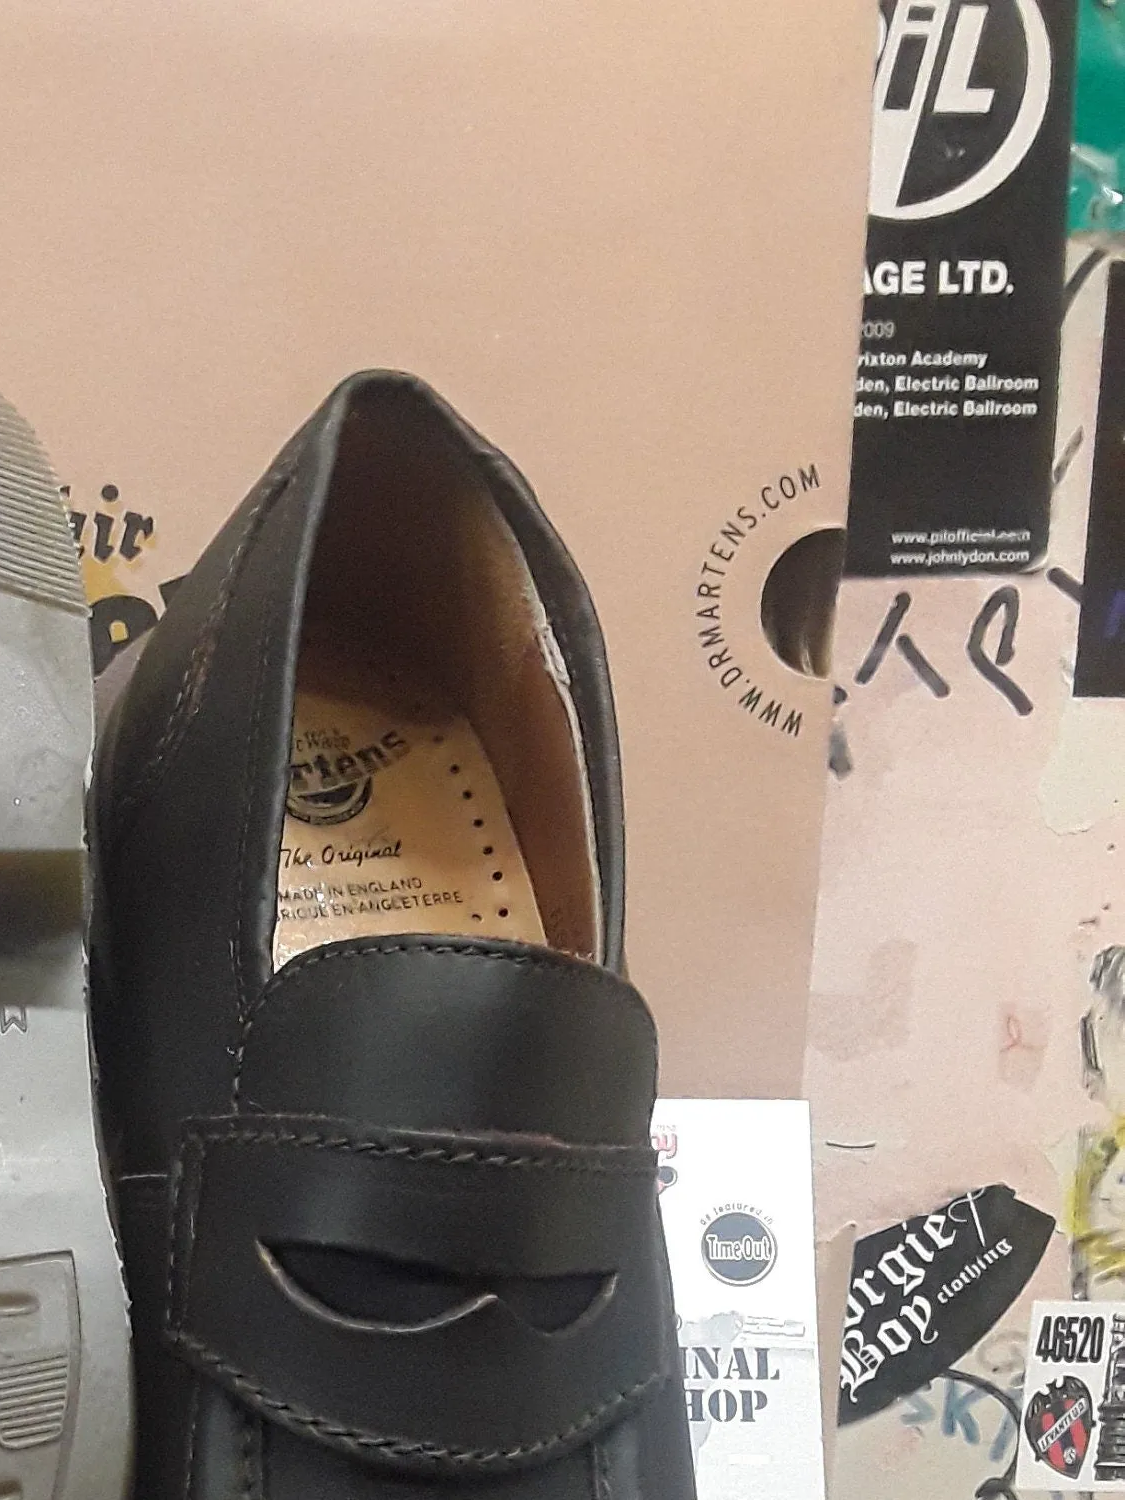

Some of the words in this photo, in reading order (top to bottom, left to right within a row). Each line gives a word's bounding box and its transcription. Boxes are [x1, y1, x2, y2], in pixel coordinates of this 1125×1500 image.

[938, 260, 1014, 294] LTD.
[862, 321, 895, 338] 009
[911, 351, 988, 369] Academy
[895, 376, 960, 392] Electric
[964, 375, 1039, 391] Ballroom
[894, 401, 958, 417] Electric
[963, 400, 1038, 416] Ballroom
[890, 549, 1030, 566] www.johnlydon.com
[696, 464, 819, 737] WWW.DRMARTENS.COM
[321, 840, 402, 867] Original
[328, 884, 343, 897] IN
[349, 877, 422, 896] ENGLAND
[936, 1237, 1013, 1304] clothing
[1035, 1315, 1105, 1364] 46520
